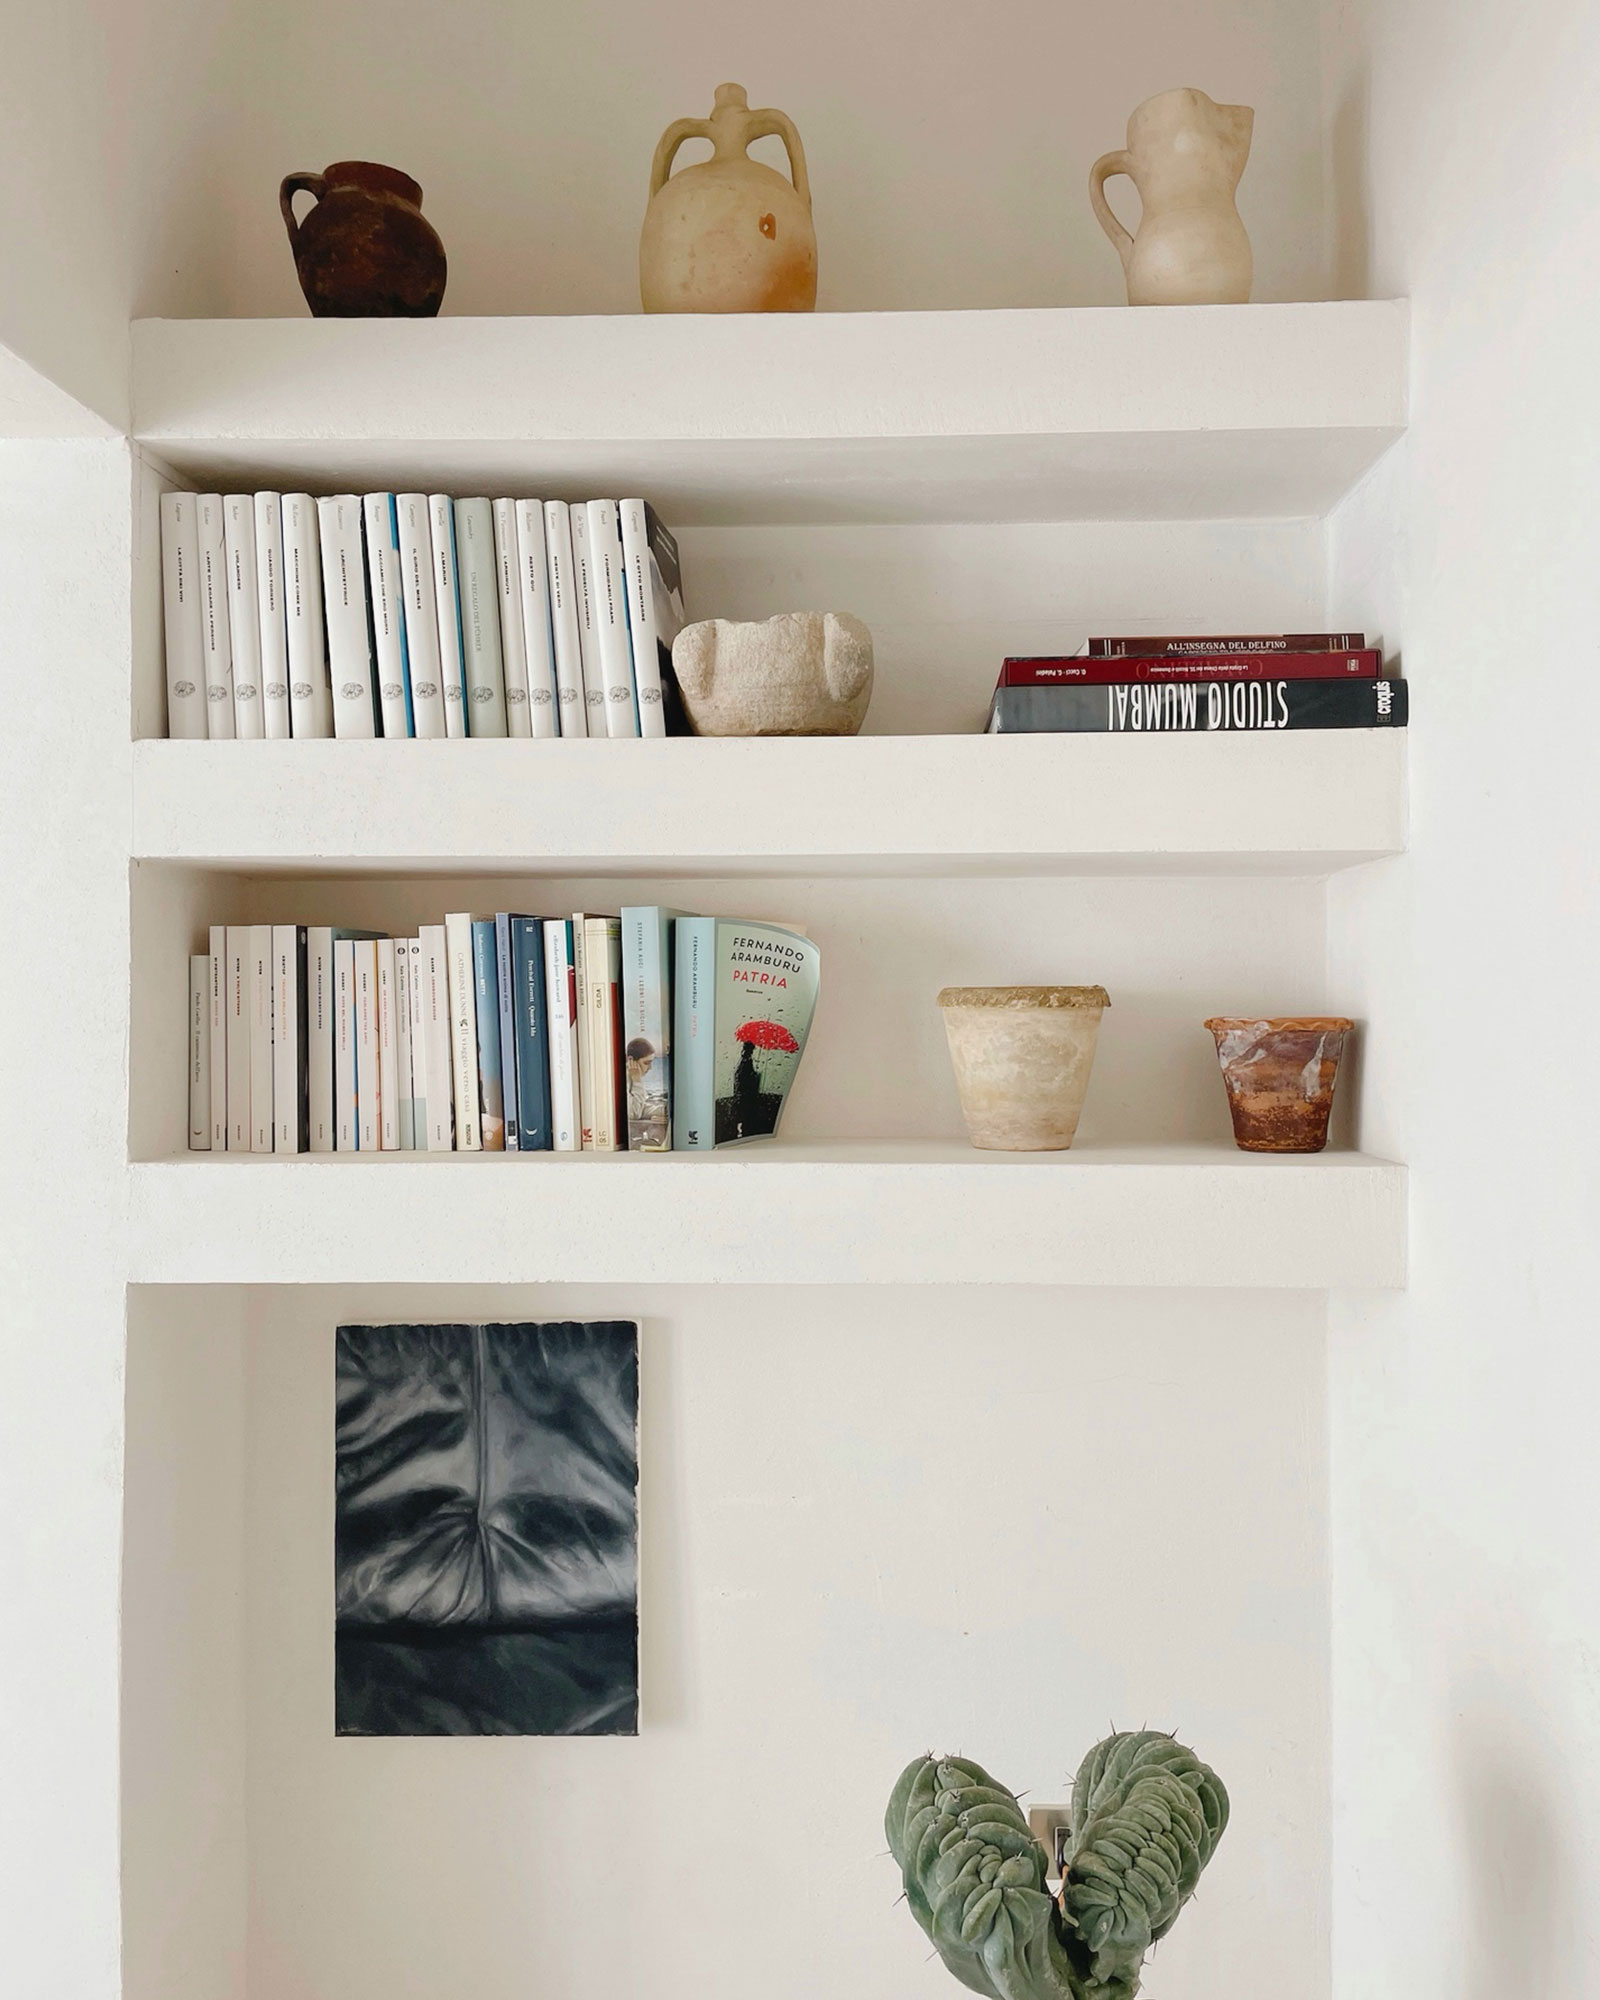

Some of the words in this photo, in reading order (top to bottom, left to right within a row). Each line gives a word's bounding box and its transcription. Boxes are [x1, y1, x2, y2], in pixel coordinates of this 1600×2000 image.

[177, 547, 182, 556] LA
[470, 571, 477, 582] UN
[635, 555, 640, 564] LE
[638, 585, 646, 622] MONTAGNE
[471, 582, 479, 611] REGALO
[297, 606, 301, 617] ME
[1166, 641, 1226, 651] ALL'INSEGNA
[1228, 641, 1247, 650] DEL
[1248, 640, 1287, 649] DELFINO
[1108, 683, 1197, 731] MUMBAI
[1208, 681, 1289, 729] STUDIO
[1371, 681, 1395, 715] croquis
[733, 937, 805, 962] FERNANDO
[457, 952, 466, 991] CATHERINE
[527, 959, 535, 982] Percival
[731, 952, 801, 973] ARAMBURU
[732, 970, 788, 989] PATRIA
[459, 992, 467, 1017] DUNNE
[528, 1005, 536, 1026] Quanto
[639, 1000, 645, 1008] DI
[460, 1038, 470, 1068] viaggio
